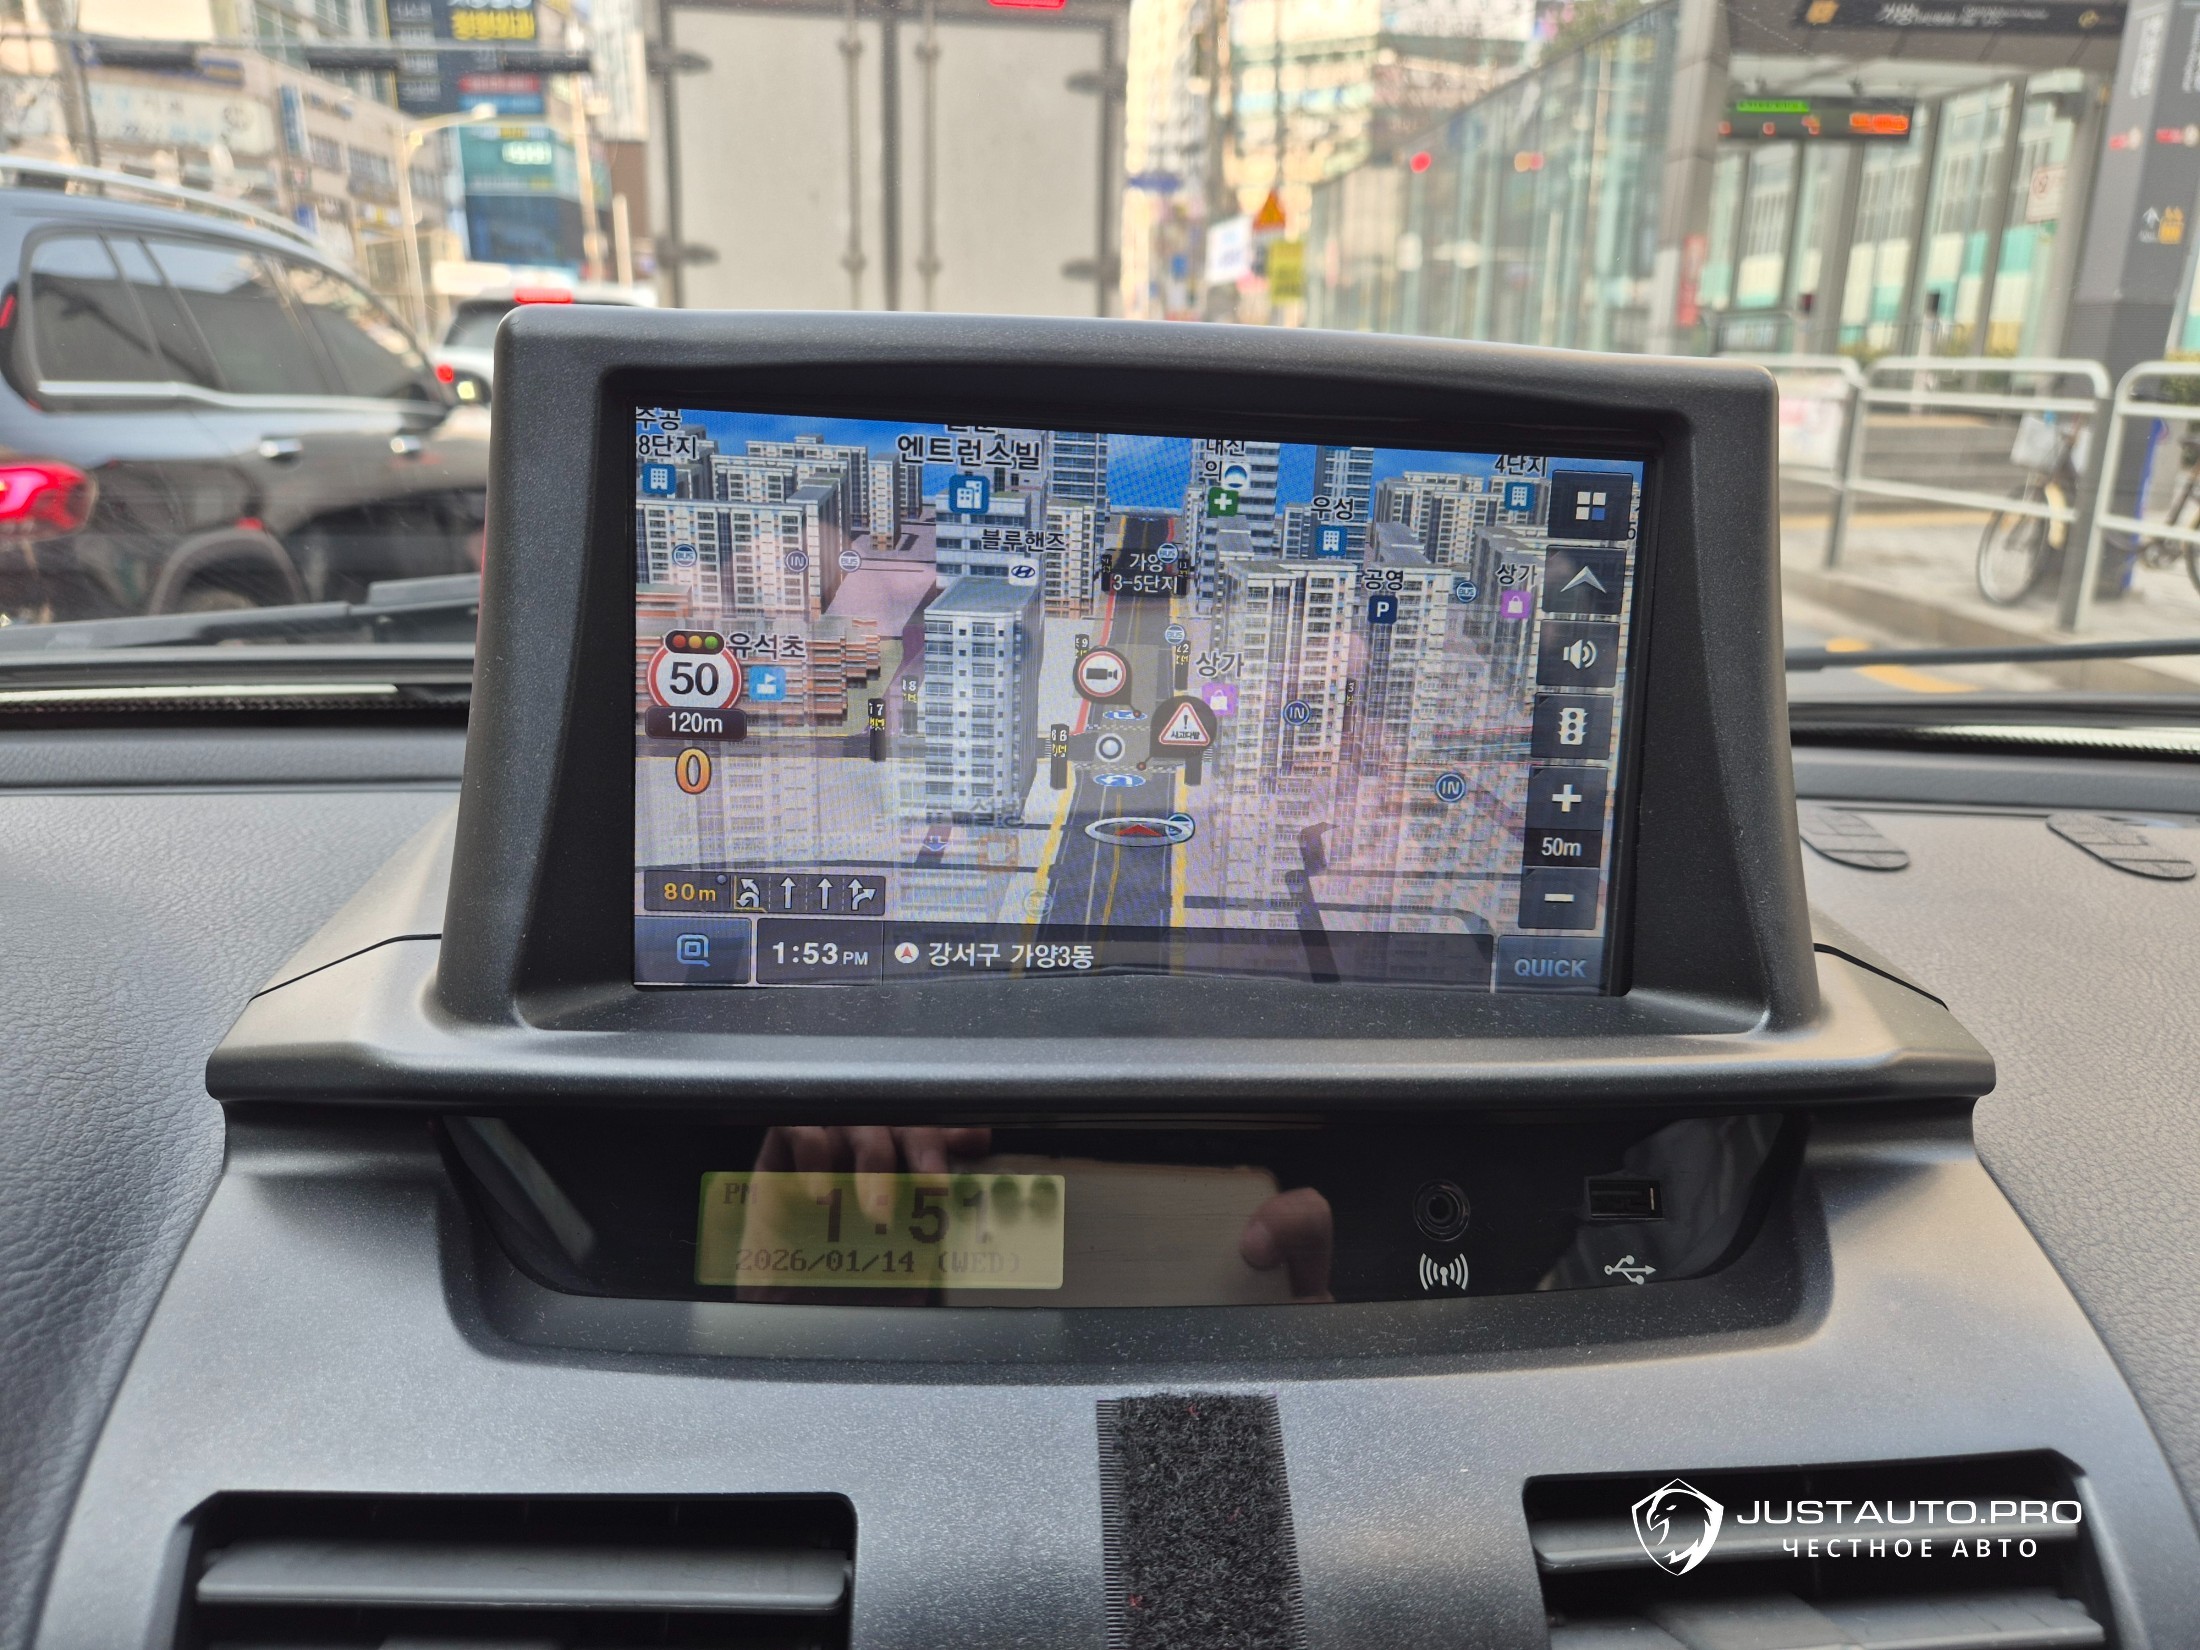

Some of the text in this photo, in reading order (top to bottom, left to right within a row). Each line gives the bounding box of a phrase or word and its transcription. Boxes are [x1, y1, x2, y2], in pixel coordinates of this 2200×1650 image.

[638, 435, 698, 460] 8단지
[1310, 497, 1354, 520] 우성
[1363, 569, 1405, 592] 공영
[1496, 563, 1537, 586] 상가
[1376, 602, 1389, 618] P
[728, 632, 807, 661] 유석초
[1195, 652, 1245, 676] 상가
[669, 661, 719, 696] 50
[668, 711, 723, 733] 120m
[674, 747, 712, 795] 0
[1541, 837, 1582, 857] 50m
[663, 882, 717, 902] 80m
[772, 941, 869, 966] 1:53 PM
[928, 941, 1095, 969] 강서구 가양3동
[1514, 958, 1587, 978] QUICK
[735, 1250, 915, 1273] 2026/01/14
